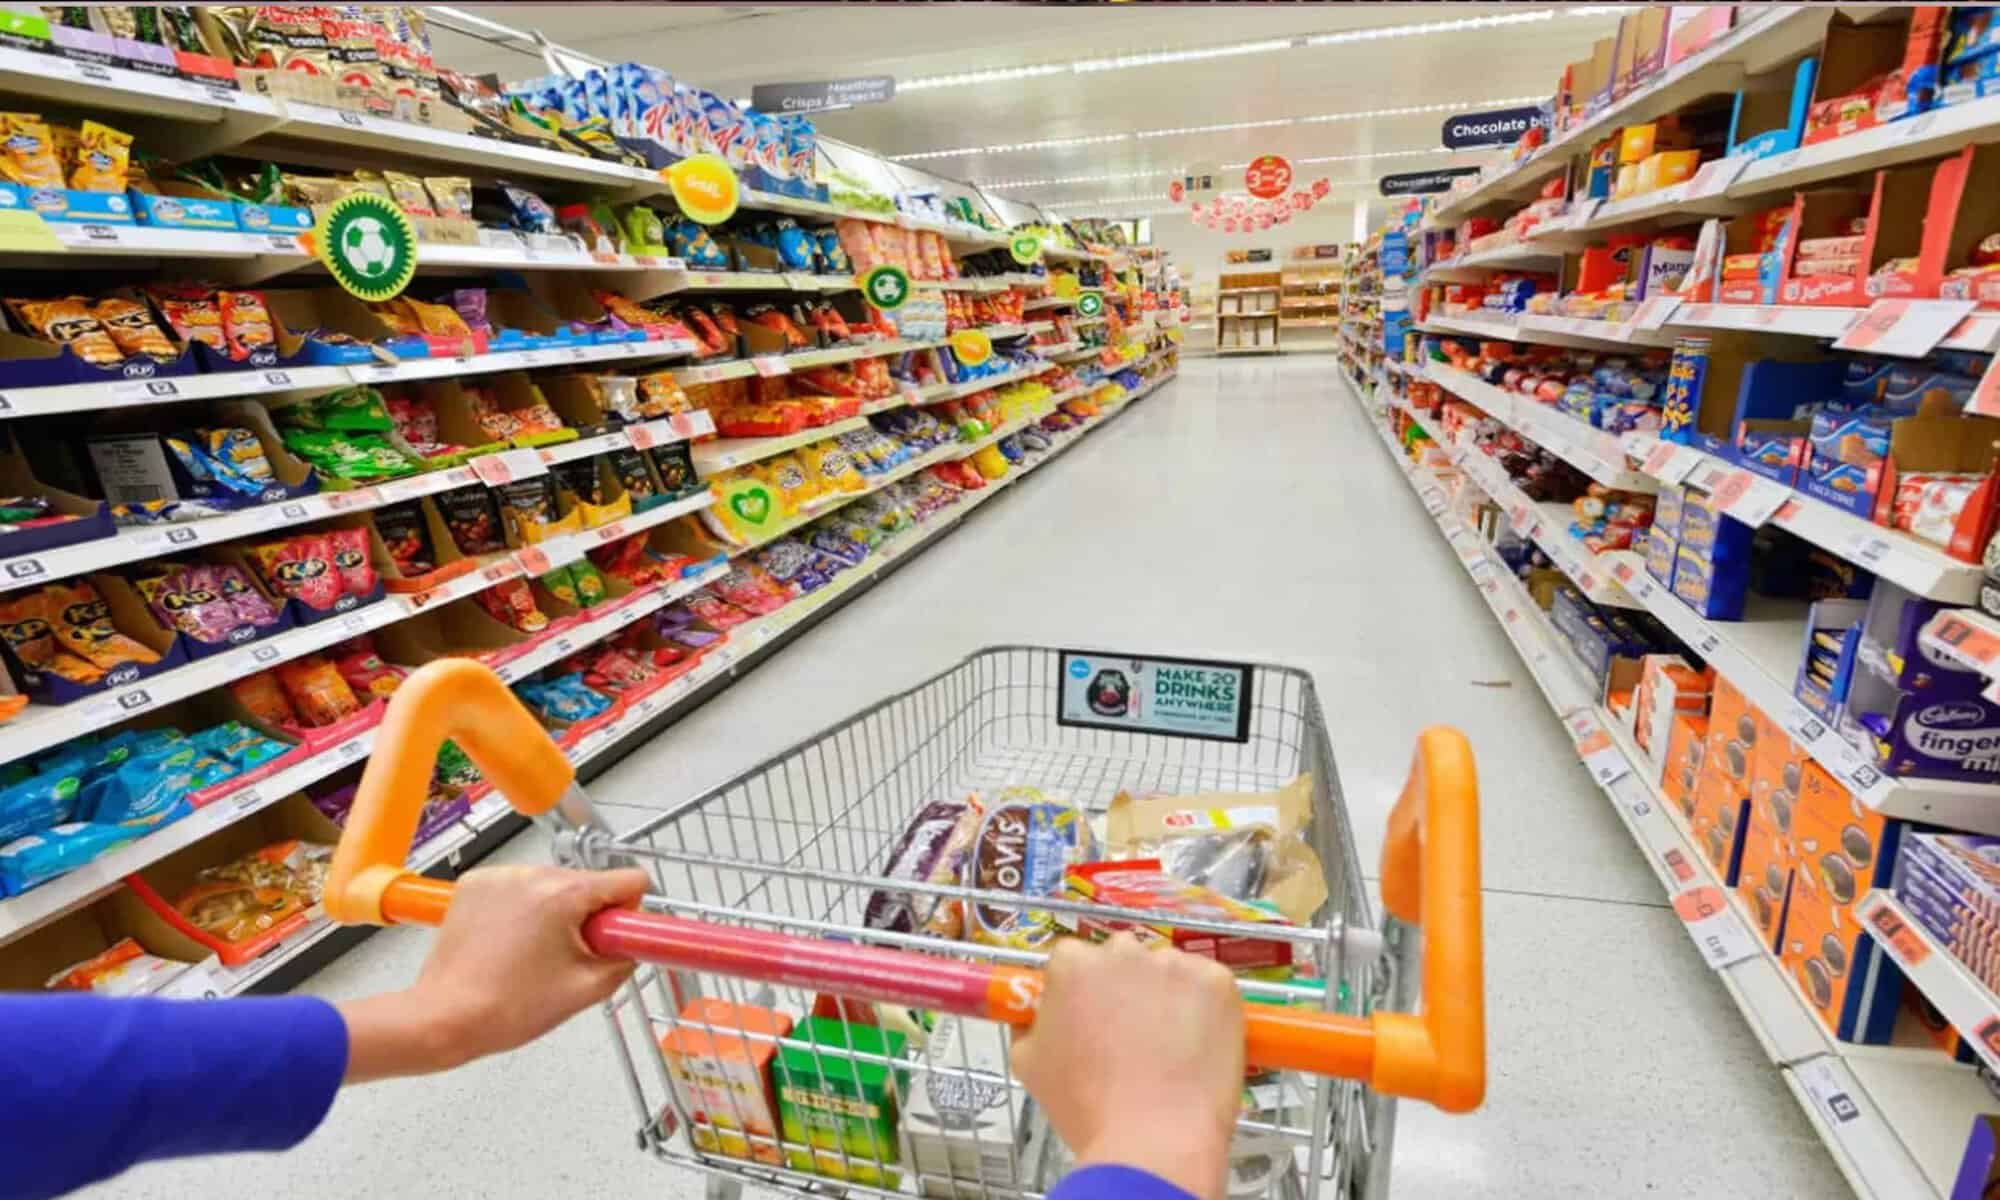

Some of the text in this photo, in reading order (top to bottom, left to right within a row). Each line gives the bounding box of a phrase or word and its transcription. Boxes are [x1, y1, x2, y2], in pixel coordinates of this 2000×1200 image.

[781, 91, 886, 112] Crisps & Snacks
[1452, 118, 1527, 138] Chocolate
[1246, 168, 1290, 187] 3 2
[1156, 667, 1237, 685] MAKE 20
[1155, 681, 1236, 701] DRINKS
[1154, 698, 1234, 713] ANYWHERE
